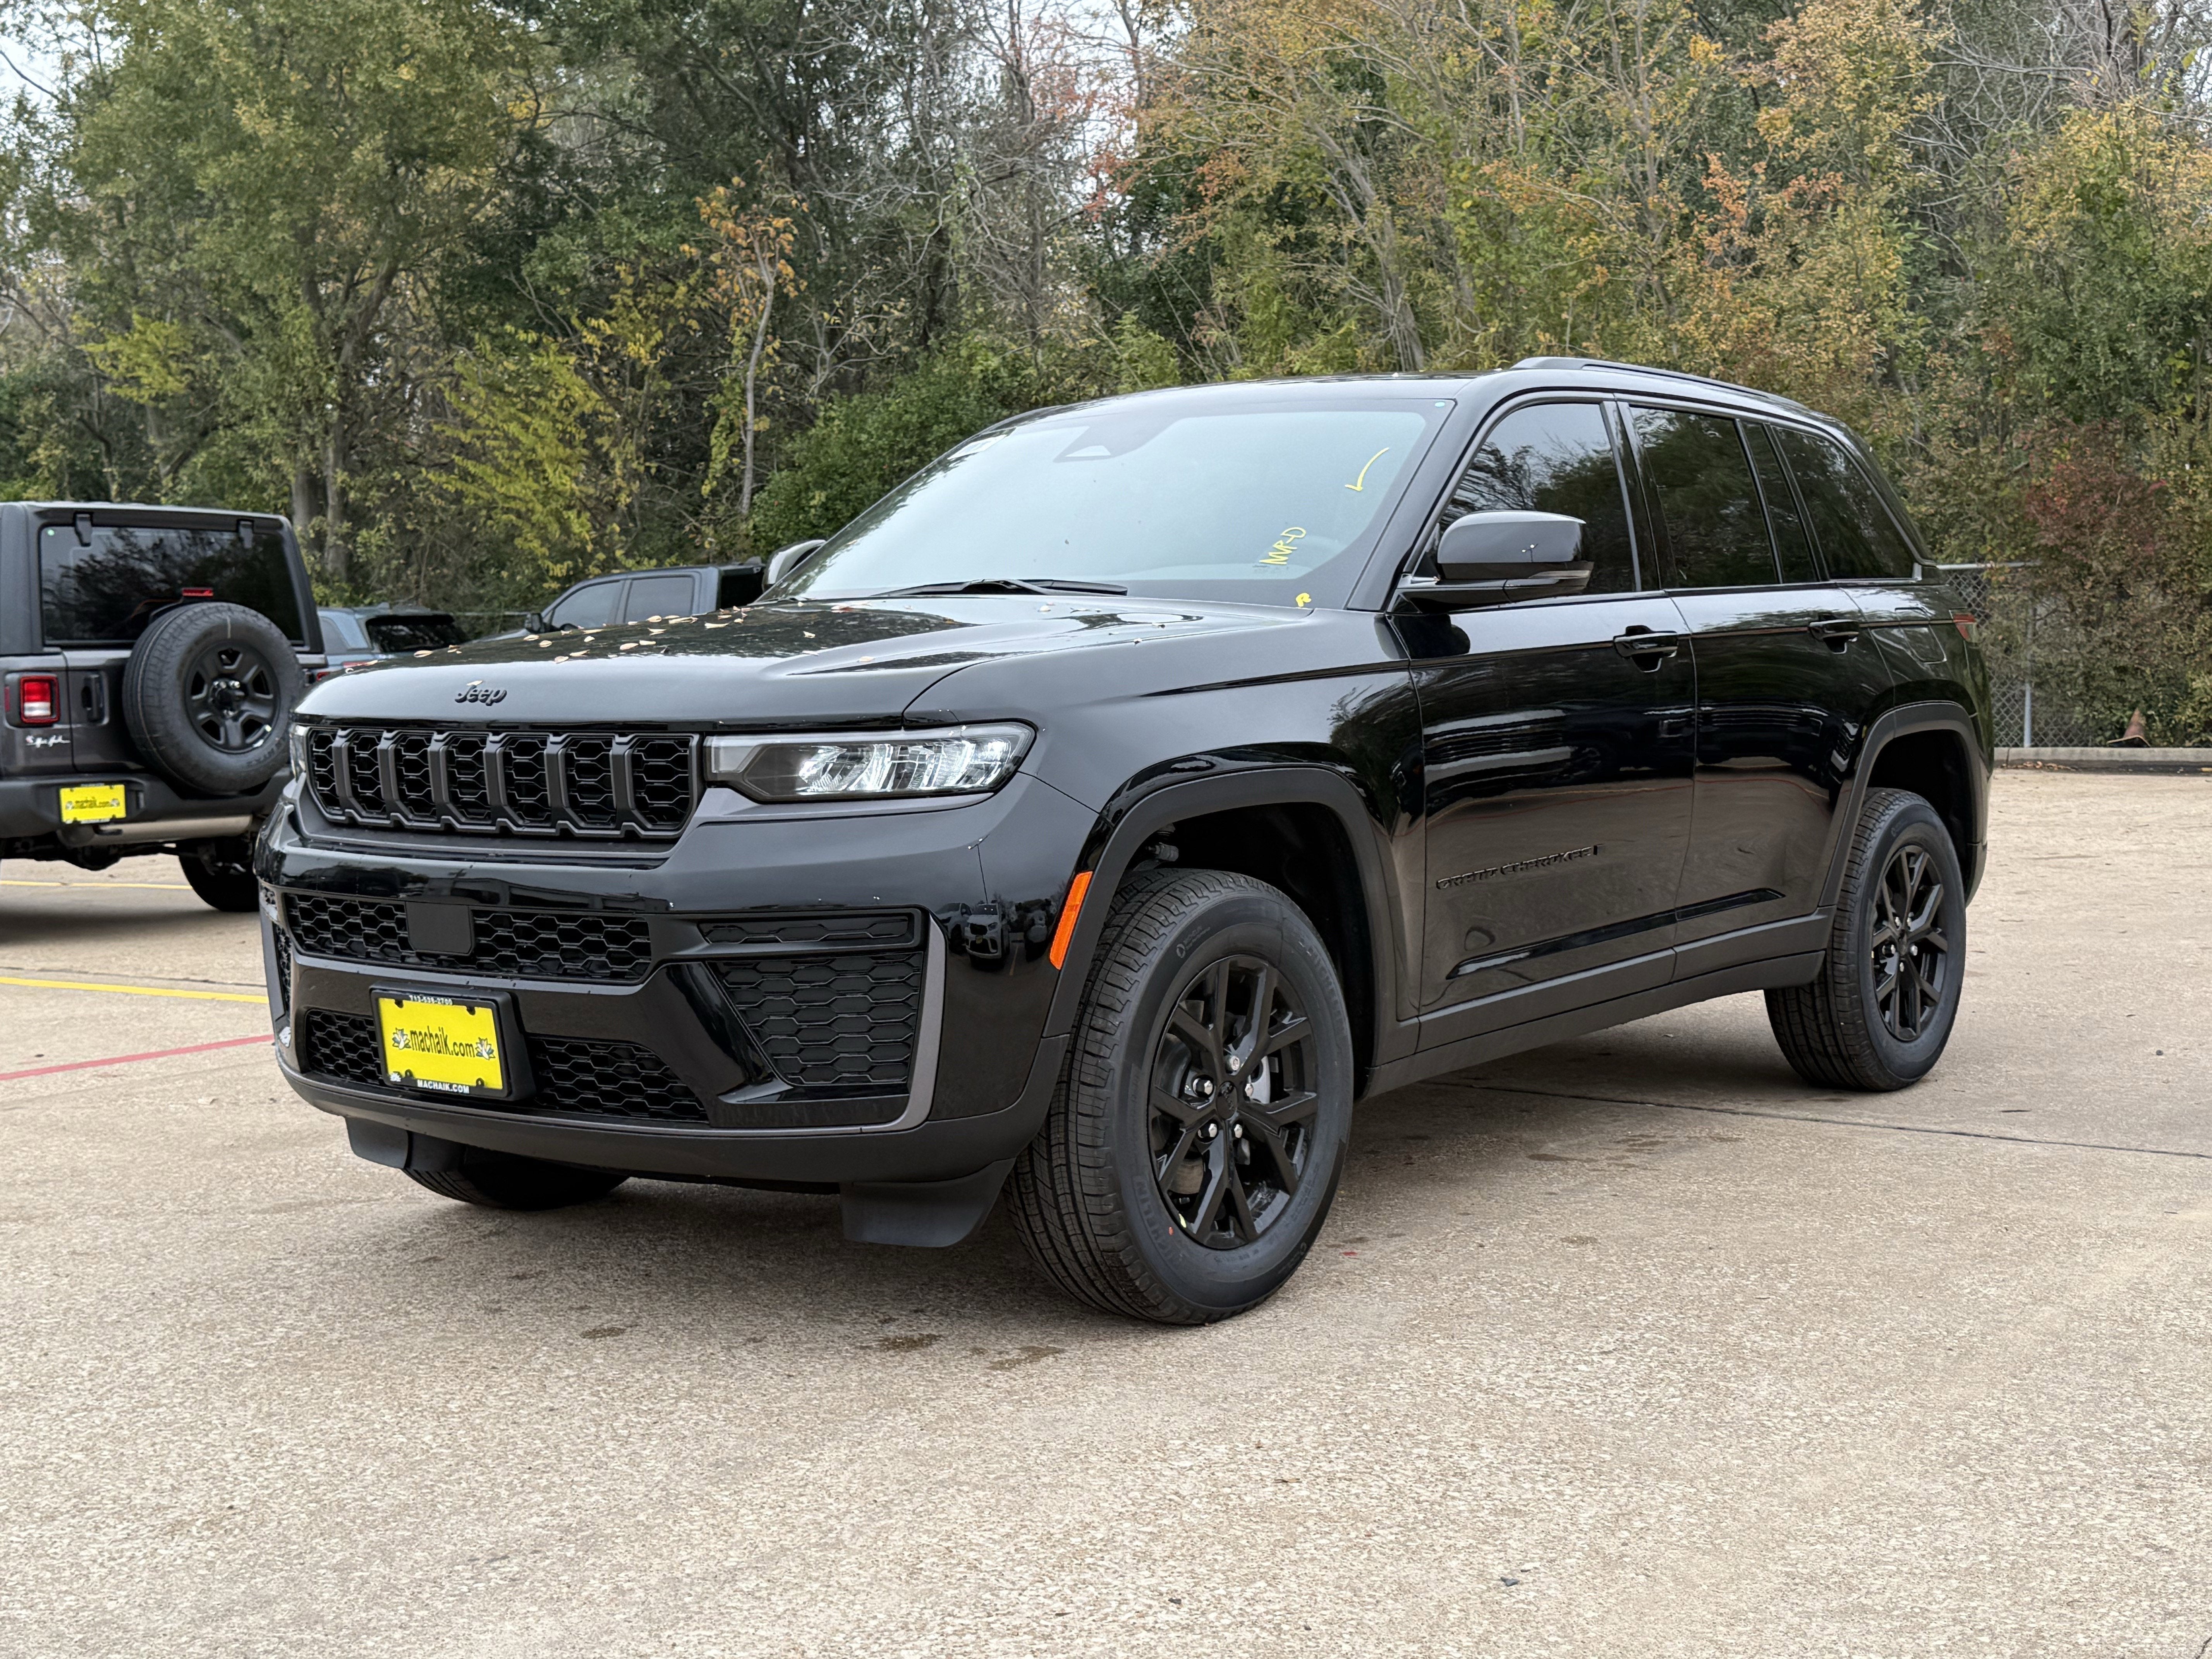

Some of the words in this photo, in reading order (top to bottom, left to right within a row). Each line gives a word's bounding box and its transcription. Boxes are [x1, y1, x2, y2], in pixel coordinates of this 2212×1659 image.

[455, 685, 507, 706] Jeep
[410, 1025, 475, 1058] machaik.com
[417, 1080, 469, 1094] MACHAIK.COM
